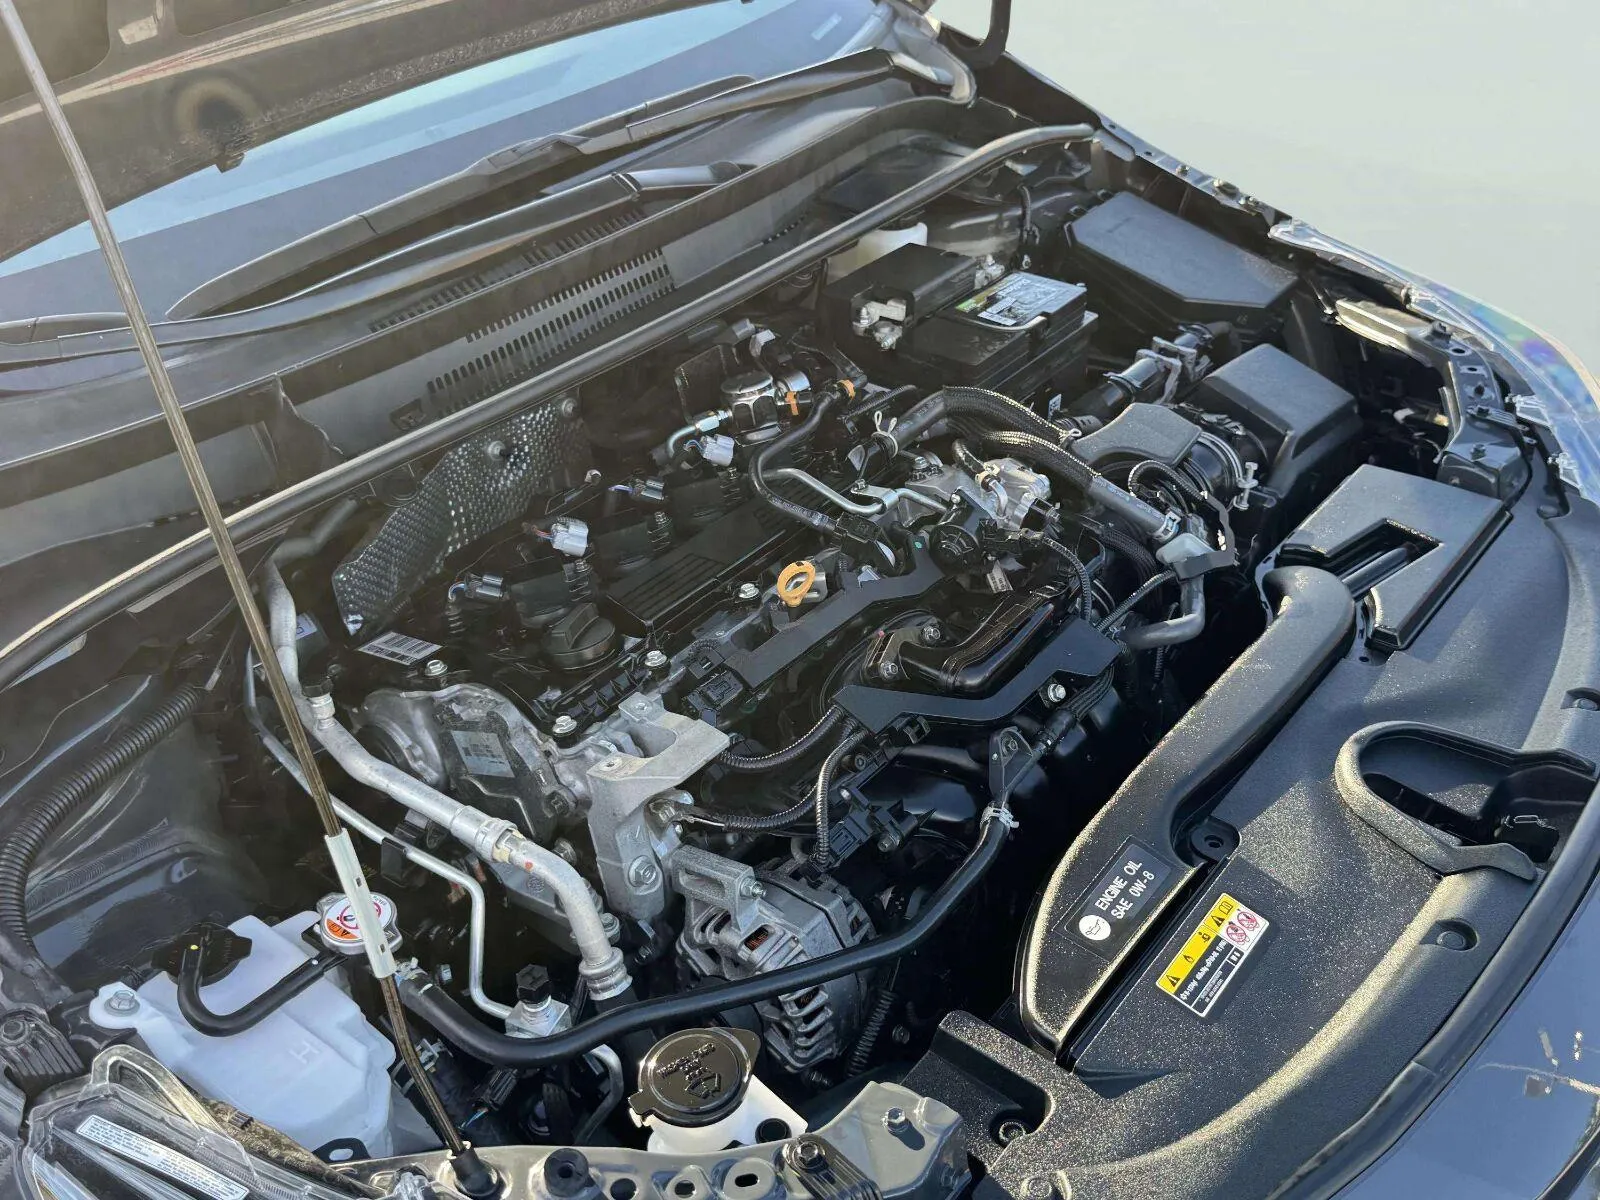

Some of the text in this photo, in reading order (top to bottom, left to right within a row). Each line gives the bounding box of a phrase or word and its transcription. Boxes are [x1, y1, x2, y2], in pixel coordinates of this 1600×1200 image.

[1095, 860, 1142, 911] ENGINE OIL
[1111, 871, 1155, 919] SAE 0W-8
